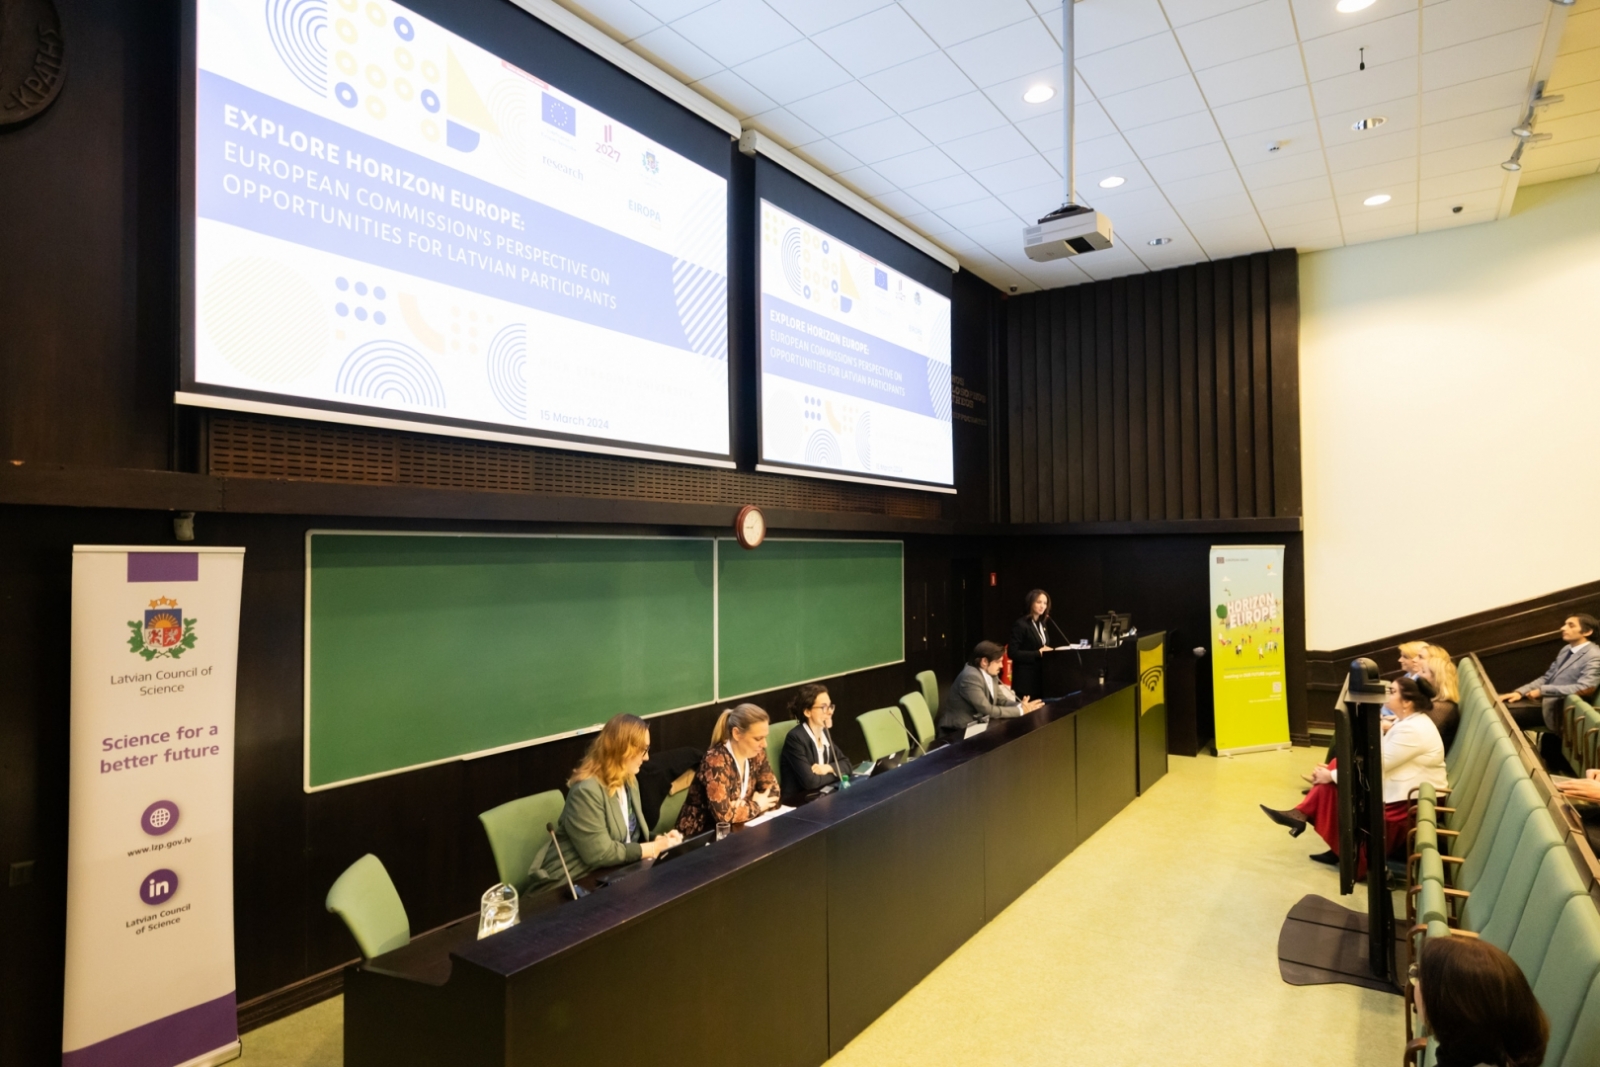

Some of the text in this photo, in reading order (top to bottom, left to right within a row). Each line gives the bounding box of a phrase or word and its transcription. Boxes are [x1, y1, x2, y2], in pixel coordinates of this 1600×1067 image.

[595, 142, 621, 163] 2027
[224, 104, 526, 231] EXPLORE HORIZON EUROPE:
[542, 155, 584, 181] research
[224, 141, 610, 286] EUROPEAN COMMISSION'S PERSPECTIVE ON
[628, 199, 661, 222] EIROPA
[223, 174, 617, 310] OPPORTUNITIES FOR LATVIAN PARTICIPANTS
[770, 309, 870, 356] EXPLORE HORIZON EUROPE:
[770, 329, 903, 383] EUROPEAN COMMISSION'S PERSPECTIVE ON
[770, 346, 906, 397] OPPORTUNITIES FOR LATVIAN PARTICIPANTS
[540, 409, 609, 430] 15 March 2024
[1226, 592, 1274, 614] HORIZON
[1229, 605, 1277, 629] EUROPE
[110, 665, 213, 685] Latvian Council of
[139, 683, 185, 696] Science
[102, 725, 219, 752] Science for a
[100, 744, 220, 774] better future
[127, 836, 192, 857] www.lzp.gov.lv
[149, 878, 170, 898] in
[125, 903, 191, 928] Latvian Council
[135, 917, 181, 935] of Science
